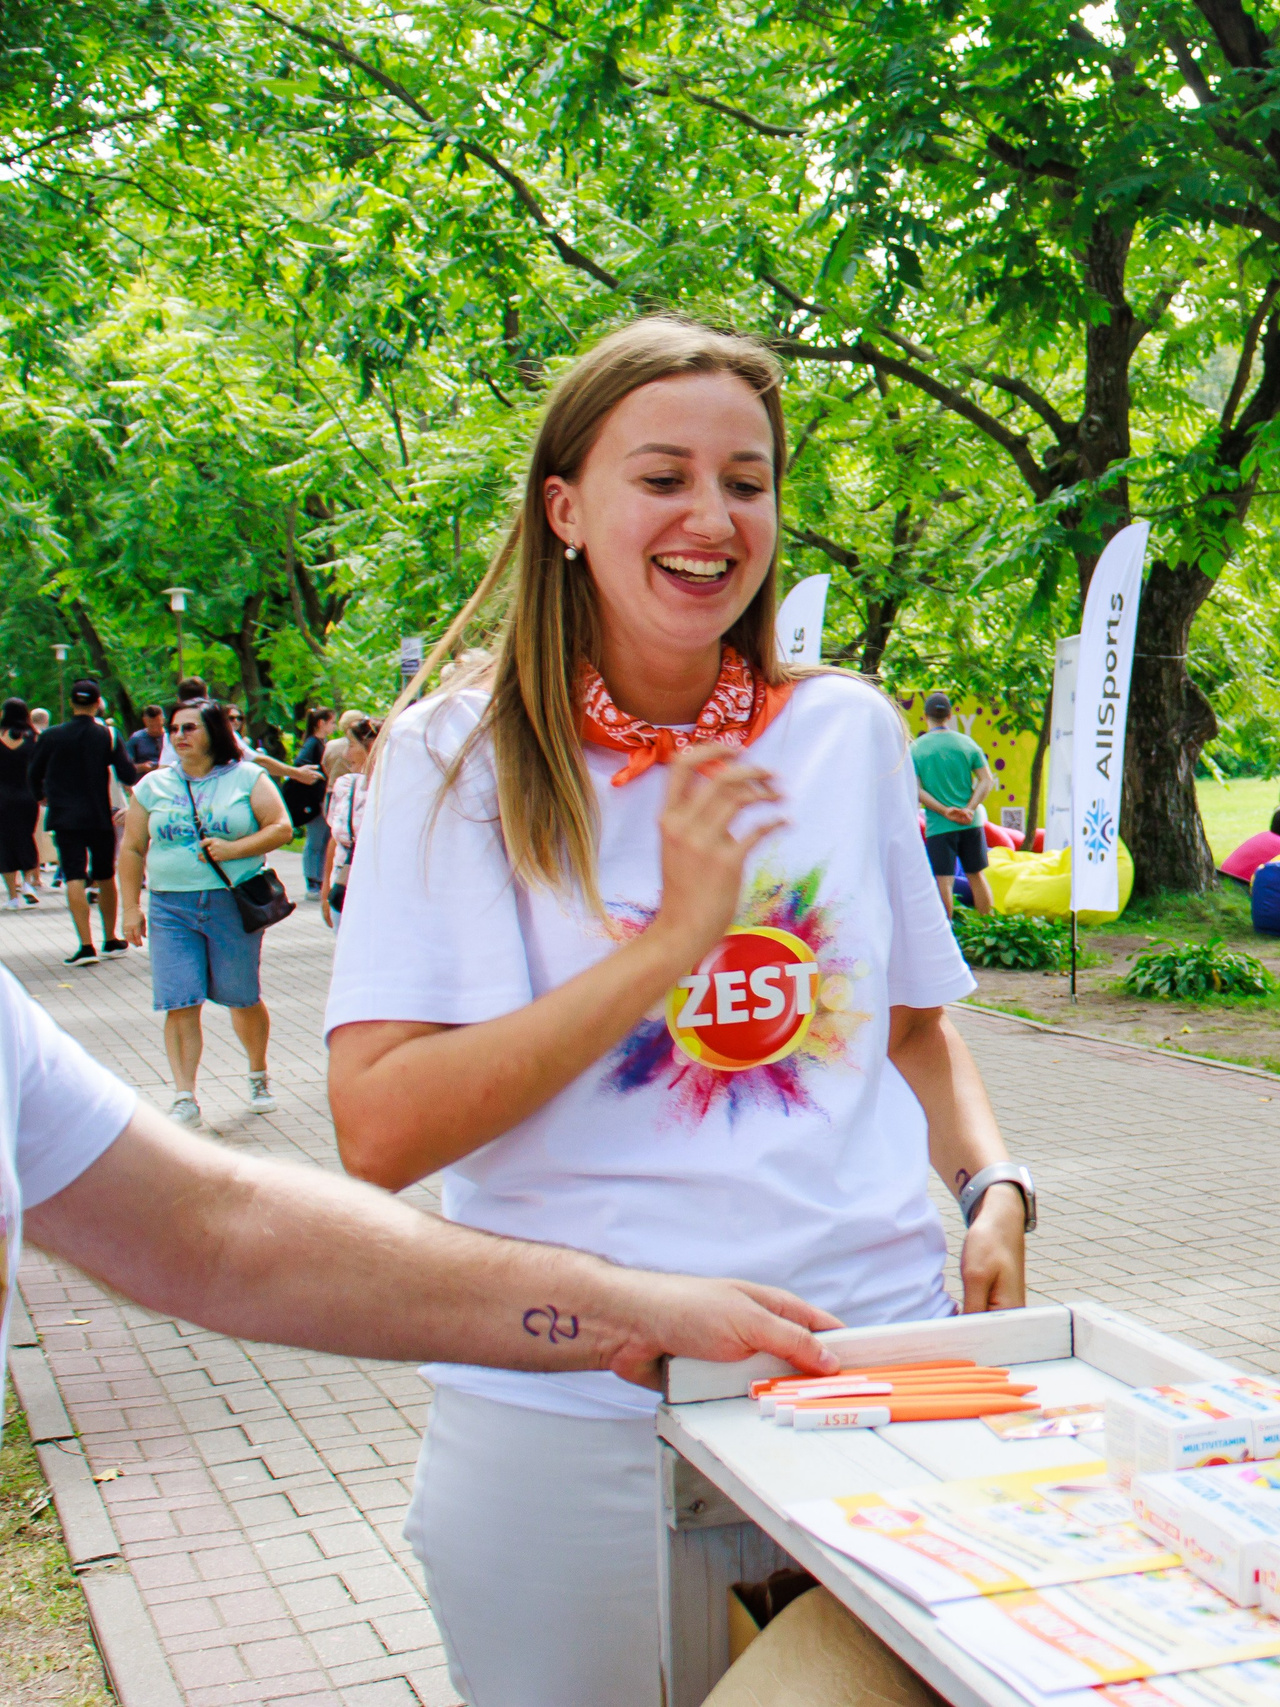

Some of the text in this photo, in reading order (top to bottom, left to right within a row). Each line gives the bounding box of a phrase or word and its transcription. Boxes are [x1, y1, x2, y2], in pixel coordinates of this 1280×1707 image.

[1095, 592, 1124, 781] AllSports
[676, 962, 818, 1029] ZEST
[1183, 1436, 1247, 1453] MULTIVITAMIN
